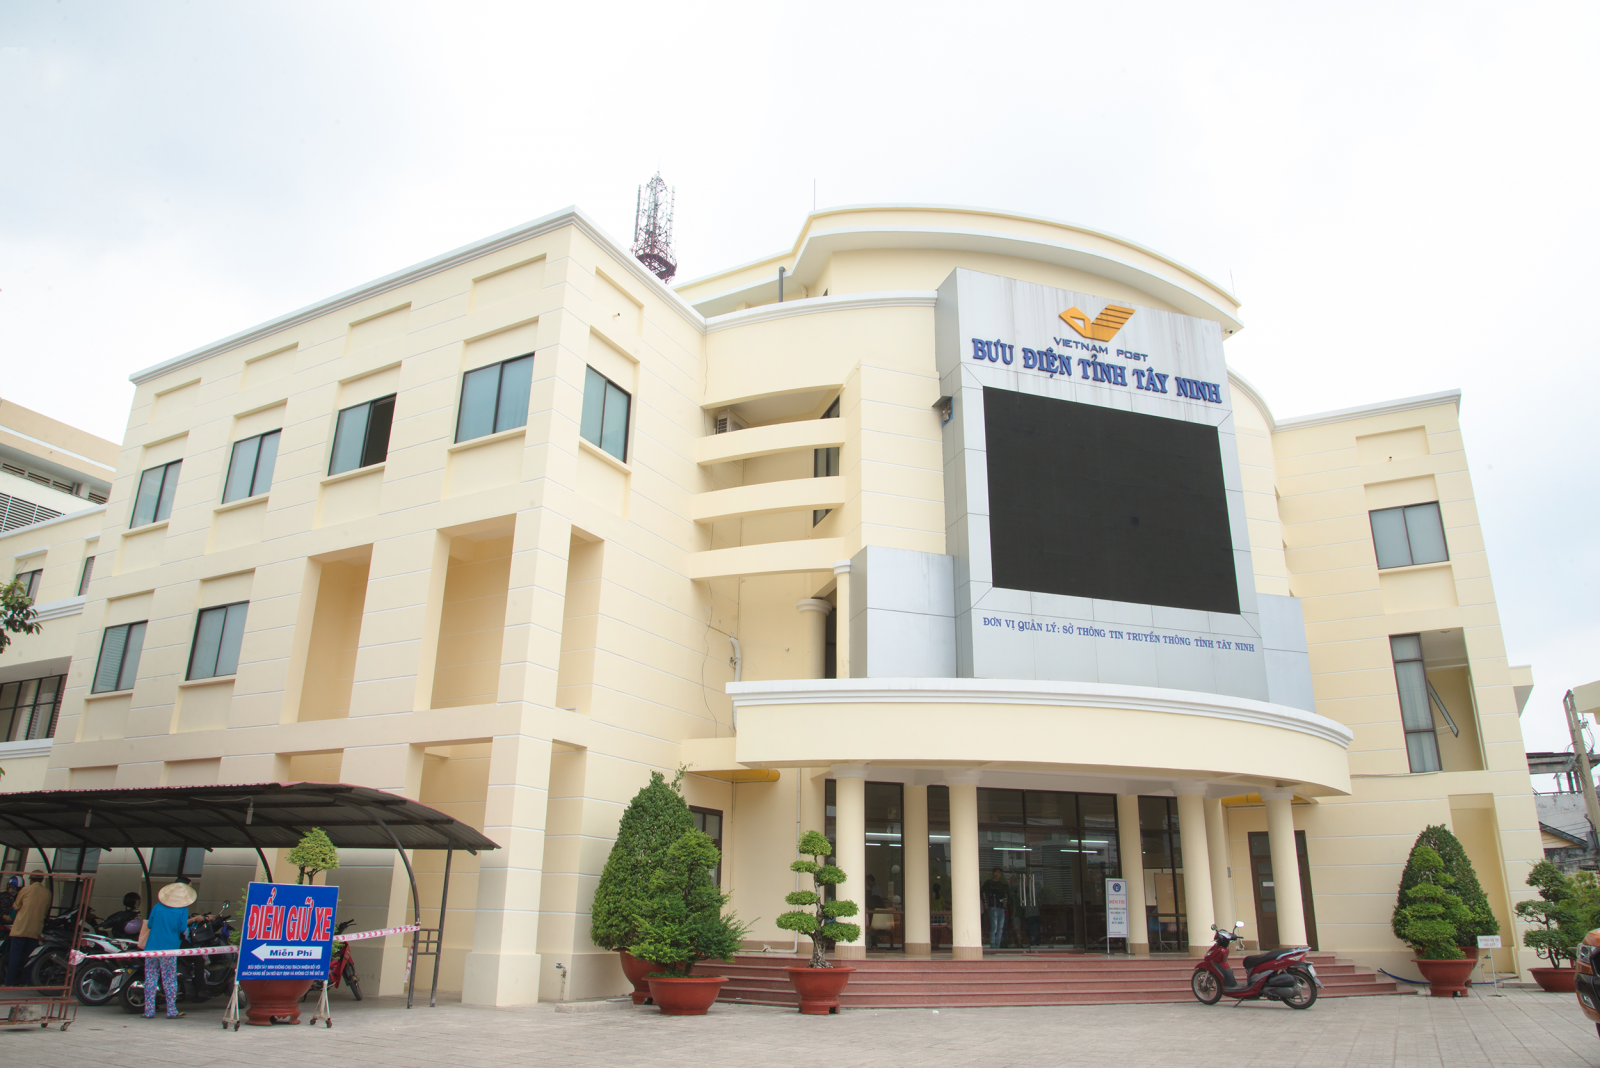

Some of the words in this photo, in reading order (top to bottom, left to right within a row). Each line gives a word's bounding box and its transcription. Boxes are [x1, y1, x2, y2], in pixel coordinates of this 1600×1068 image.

[1053, 337, 1108, 354] VIETNAM
[1116, 349, 1148, 362] POST
[971, 338, 1014, 365] BƯU
[1022, 346, 1072, 378] ĐIỆN
[1078, 353, 1128, 386] TỈNH
[1132, 366, 1169, 393] TÂY
[1175, 376, 1222, 404] NINH
[982, 616, 1002, 627] ĐƠN
[1004, 619, 1015, 630] VỊ
[1017, 619, 1043, 632] QUẢN
[1076, 626, 1106, 638] THÔNG
[1108, 630, 1124, 640] TIN
[1162, 634, 1191, 646] THÔNG
[1216, 639, 1232, 650] TÂY
[1234, 642, 1255, 652] NINH
[247, 887, 286, 941] ĐIỂM
[285, 896, 314, 942] GIỮ
[311, 907, 333, 942] XE
[269, 948, 294, 957] Miễn
